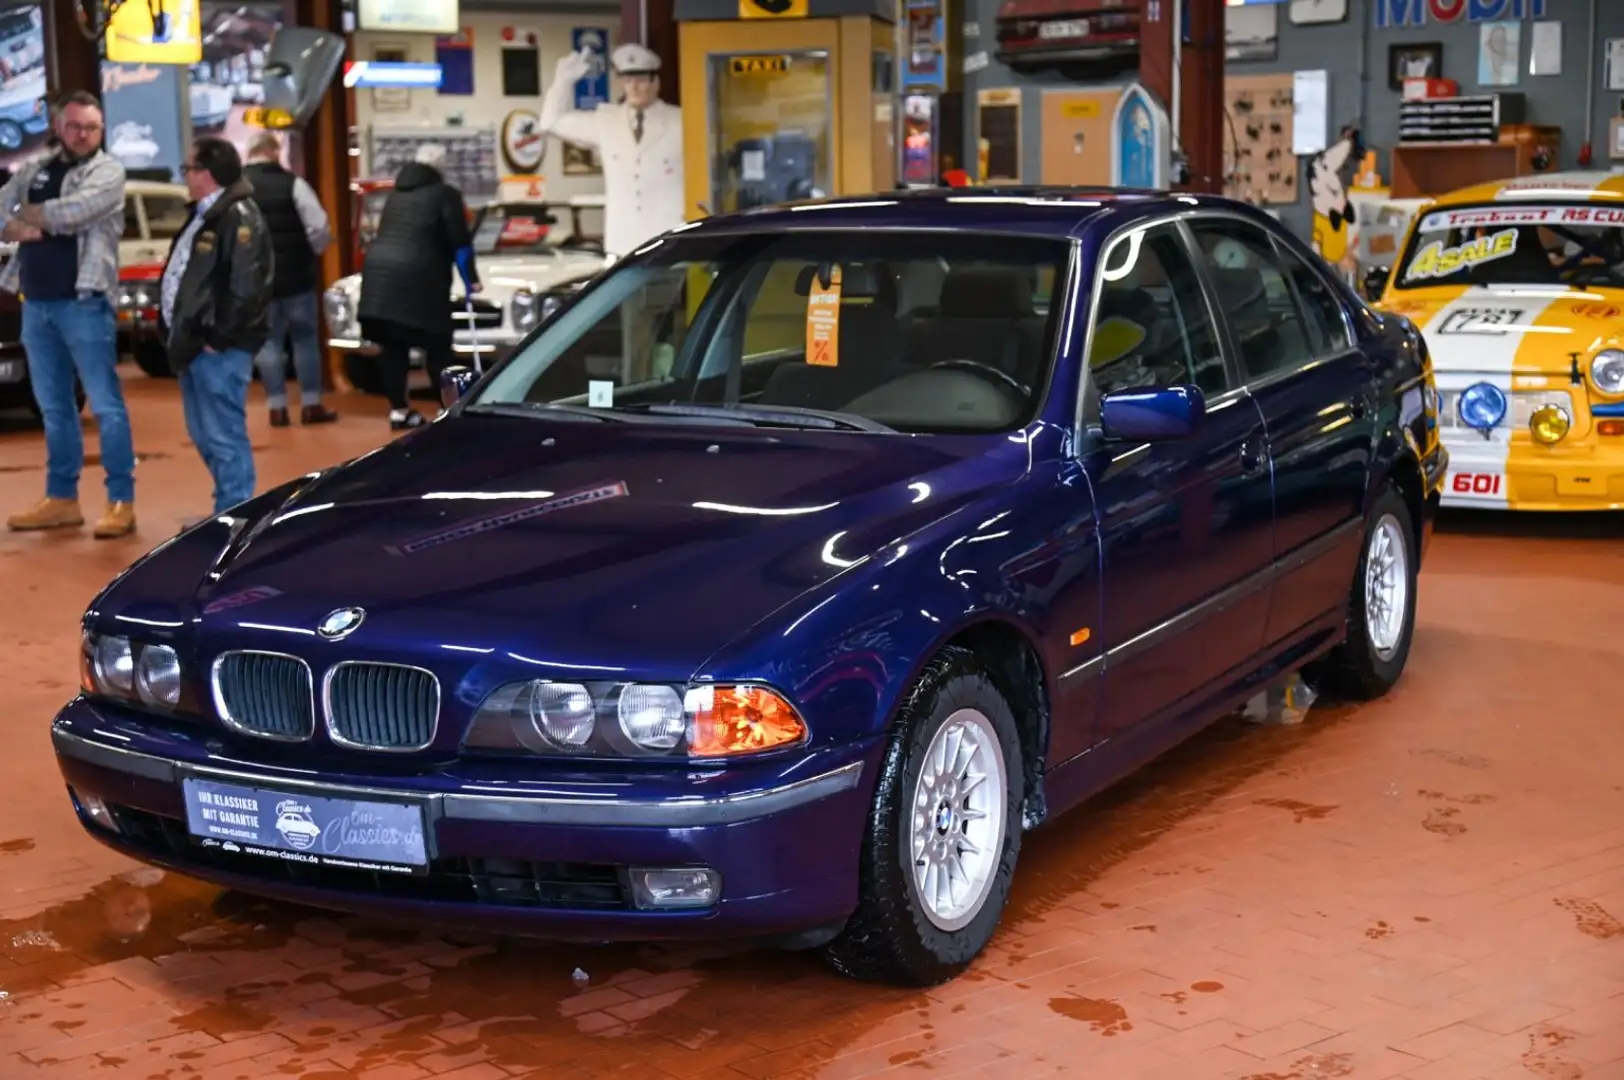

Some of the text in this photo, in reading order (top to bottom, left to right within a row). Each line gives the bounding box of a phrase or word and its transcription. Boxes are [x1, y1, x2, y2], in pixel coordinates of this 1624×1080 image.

[1593, 208, 1624, 222] CU
[1452, 473, 1500, 494] 601
[198, 791, 258, 812] IHR KLASSIKER
[202, 808, 260, 828] MIT GARANTIE
[245, 846, 319, 865] www.om-classics.de
